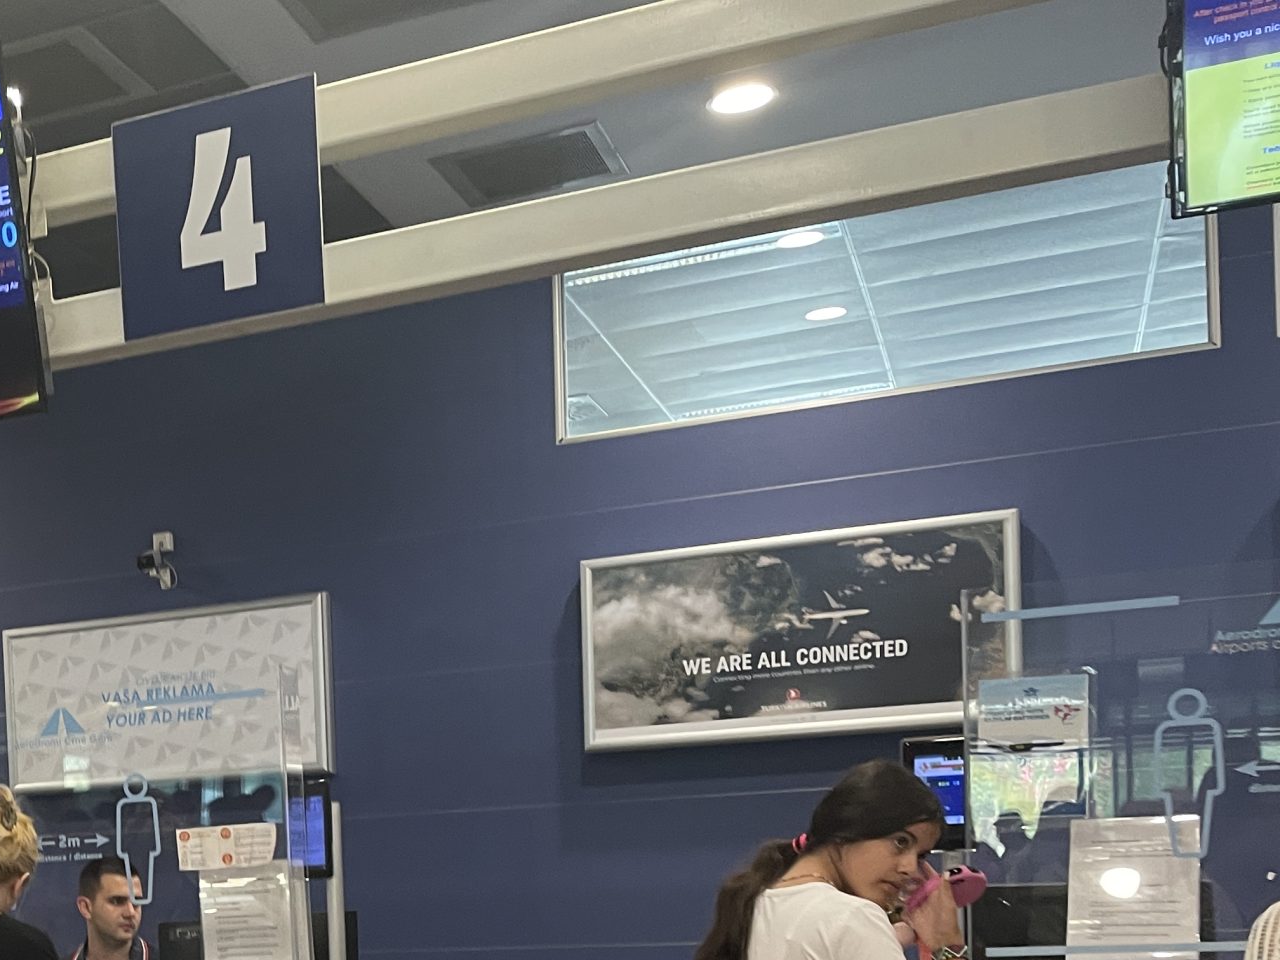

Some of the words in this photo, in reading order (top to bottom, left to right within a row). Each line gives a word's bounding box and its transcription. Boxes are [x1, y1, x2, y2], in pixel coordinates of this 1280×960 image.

[1204, 33, 1231, 46] Wish
[1233, 30, 1252, 42] you
[1255, 27, 1262, 35] a
[180, 126, 267, 292] 4
[10, 281, 19, 290] Air
[682, 656, 711, 677] WE
[717, 653, 752, 673] ARE
[757, 649, 791, 670] ALL
[796, 638, 908, 666] CONNECTED
[101, 687, 140, 704] VAŠA
[146, 682, 216, 702] REKLAMA
[106, 710, 146, 729] YOUR
[151, 710, 173, 725] AD
[177, 705, 213, 721] HERE
[58, 834, 80, 849] 2m
